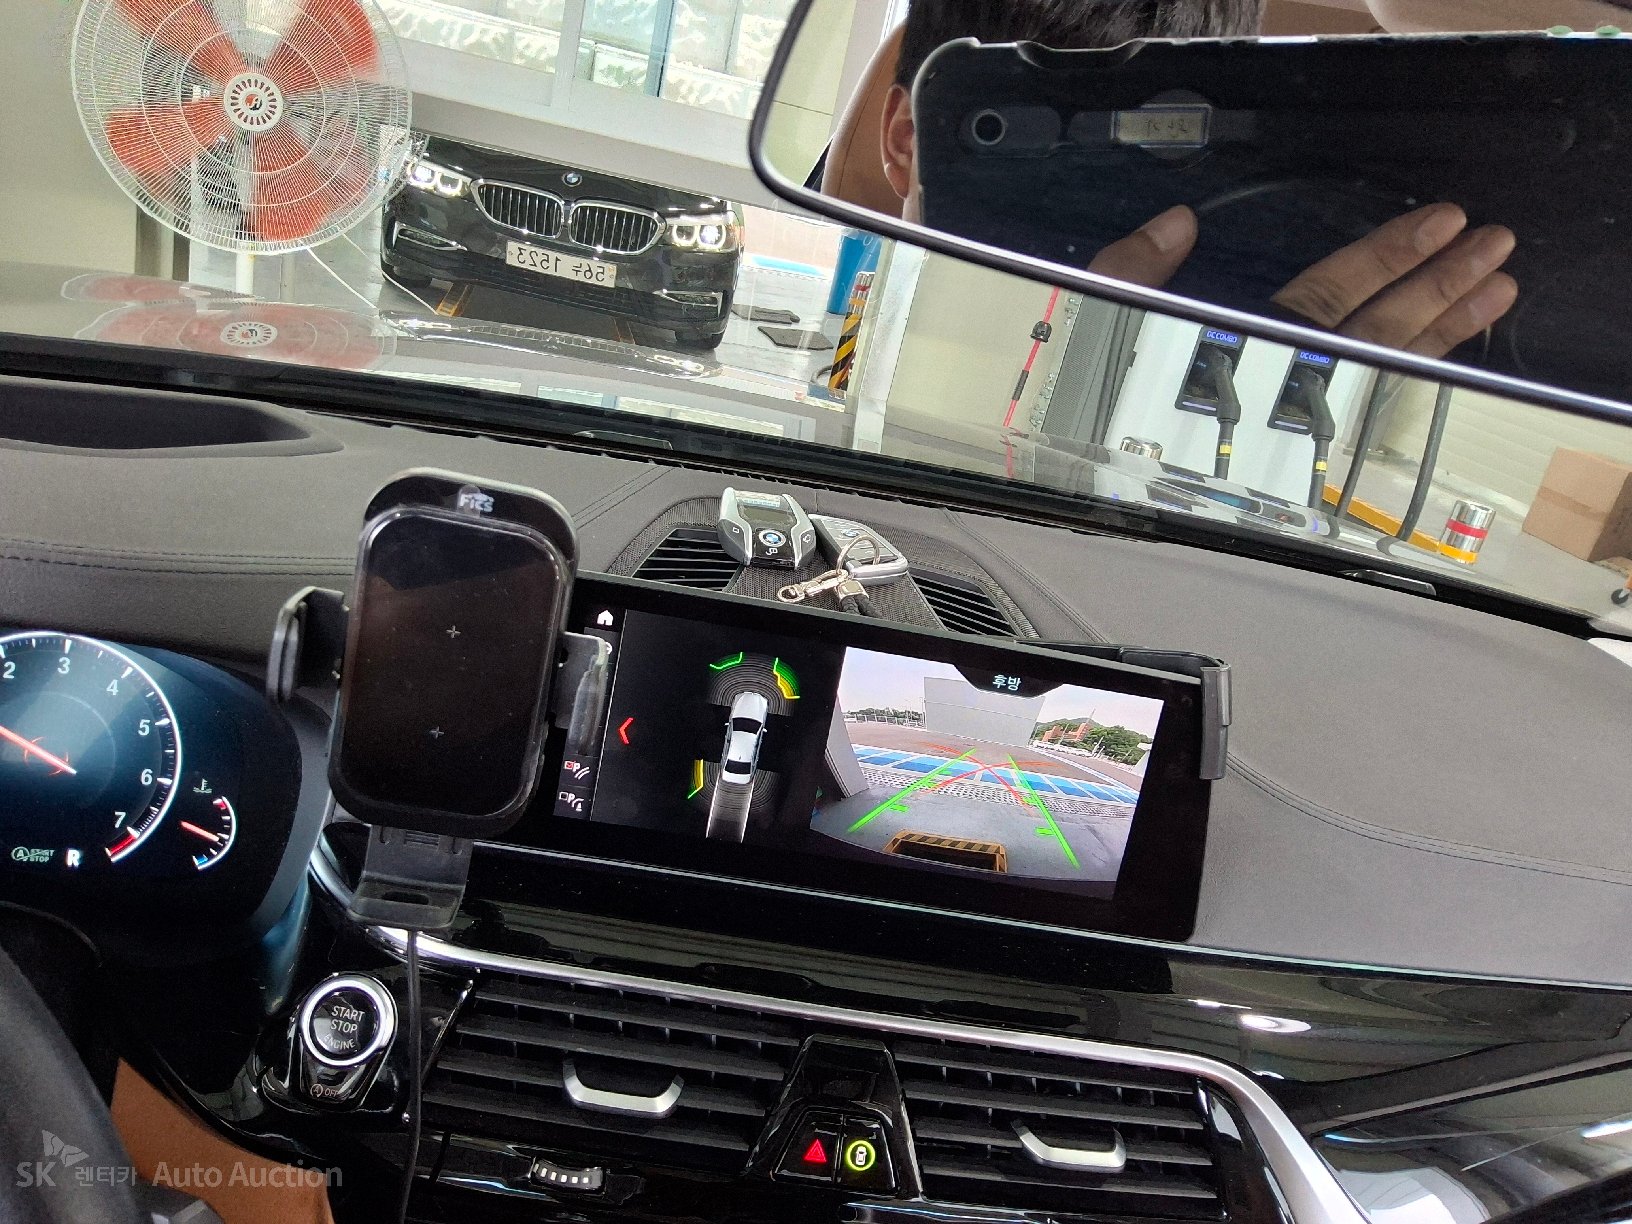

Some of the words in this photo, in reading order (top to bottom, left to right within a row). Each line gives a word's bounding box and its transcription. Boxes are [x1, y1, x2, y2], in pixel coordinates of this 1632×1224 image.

[2, 661, 16, 679] 2
[57, 657, 71, 675] 3
[106, 679, 119, 696] 4
[992, 674, 1021, 691] 후방
[137, 719, 151, 736] 5
[140, 768, 153, 786] 6
[114, 811, 127, 829] 7
[66, 849, 81, 868] R
[331, 1005, 365, 1022] START
[330, 1018, 358, 1034] STOP
[323, 1033, 356, 1051] ENGINE
